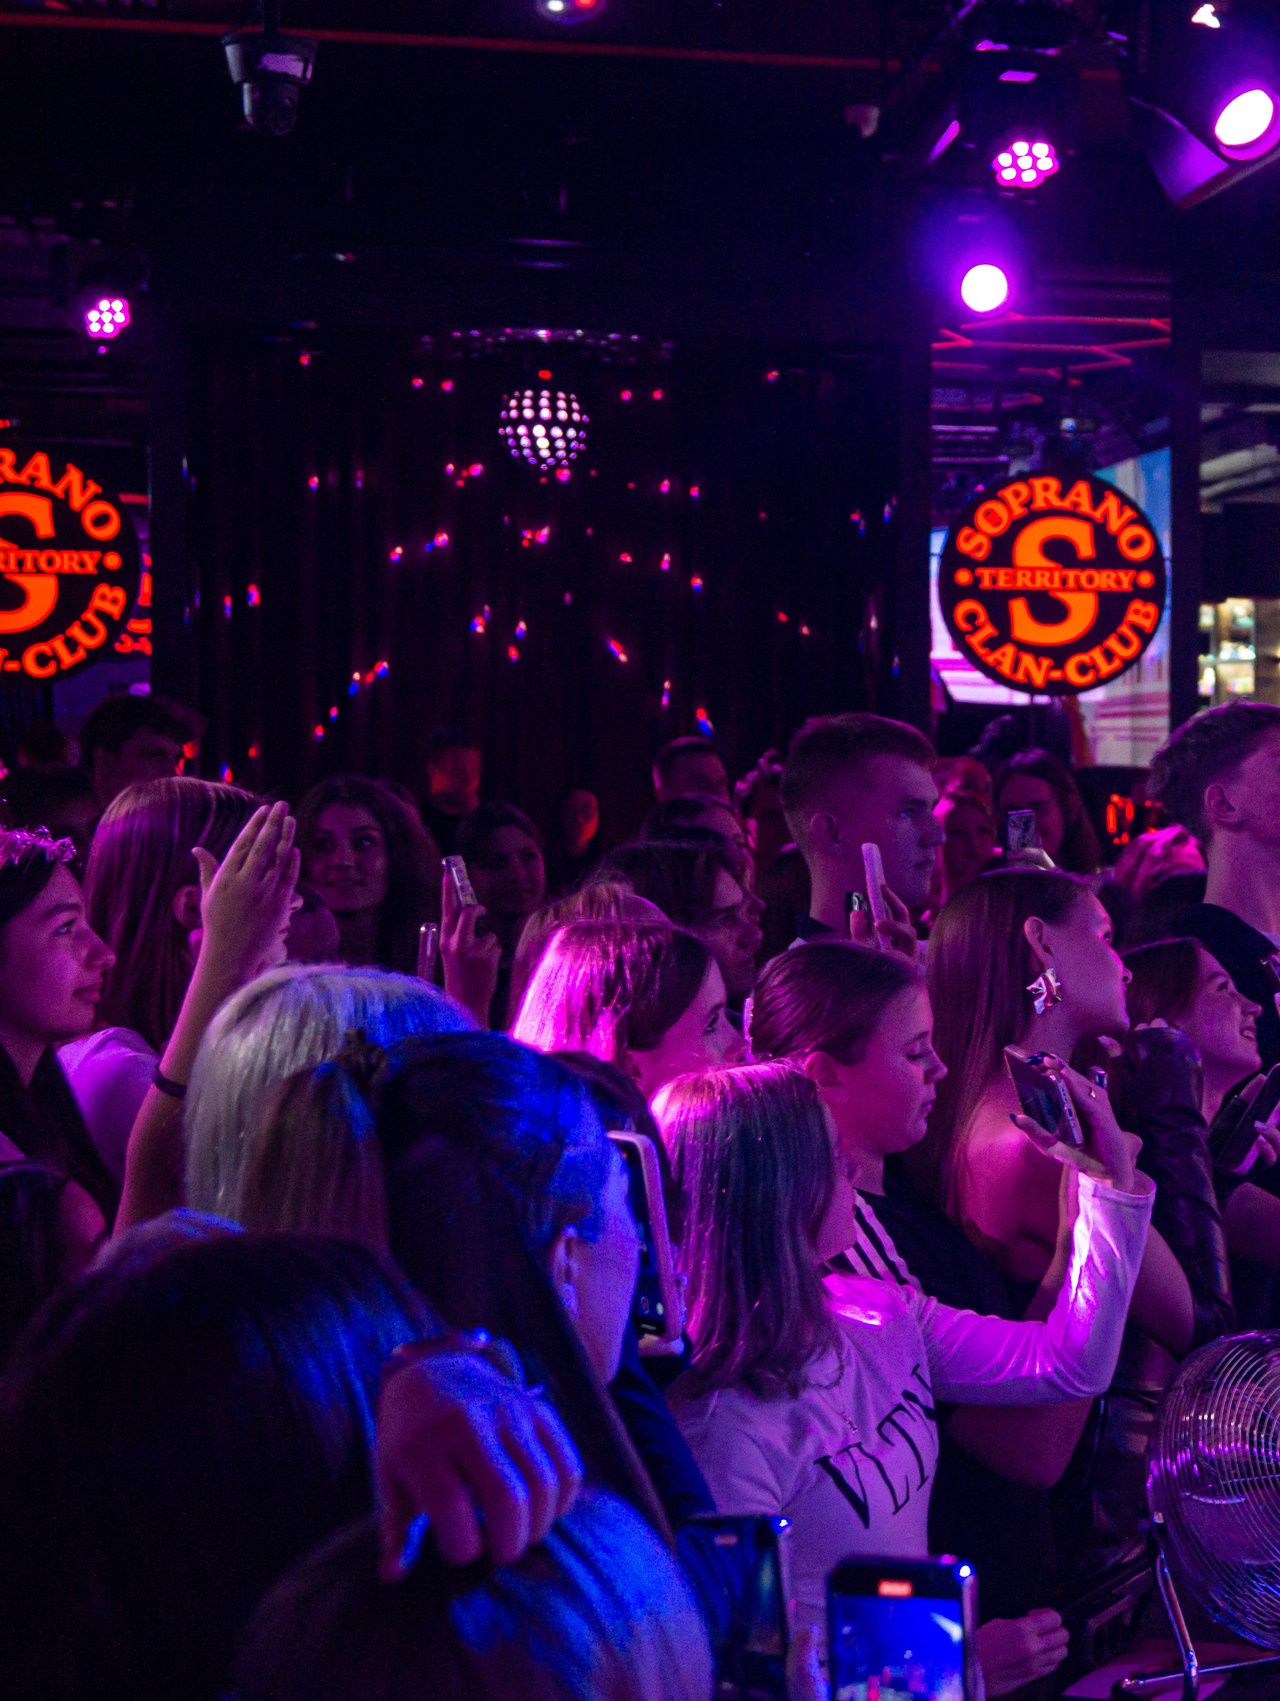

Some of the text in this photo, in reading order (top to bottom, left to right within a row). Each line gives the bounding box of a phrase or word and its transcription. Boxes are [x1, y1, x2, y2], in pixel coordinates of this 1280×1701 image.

[0, 448, 121, 541] RANO
[956, 476, 1154, 561] SOPRANO
[0, 549, 102, 574] ITORY
[974, 567, 1137, 592] TERRITORY
[0, 583, 127, 678] -CLUB
[953, 599, 1158, 688] CLAN-CLUB
